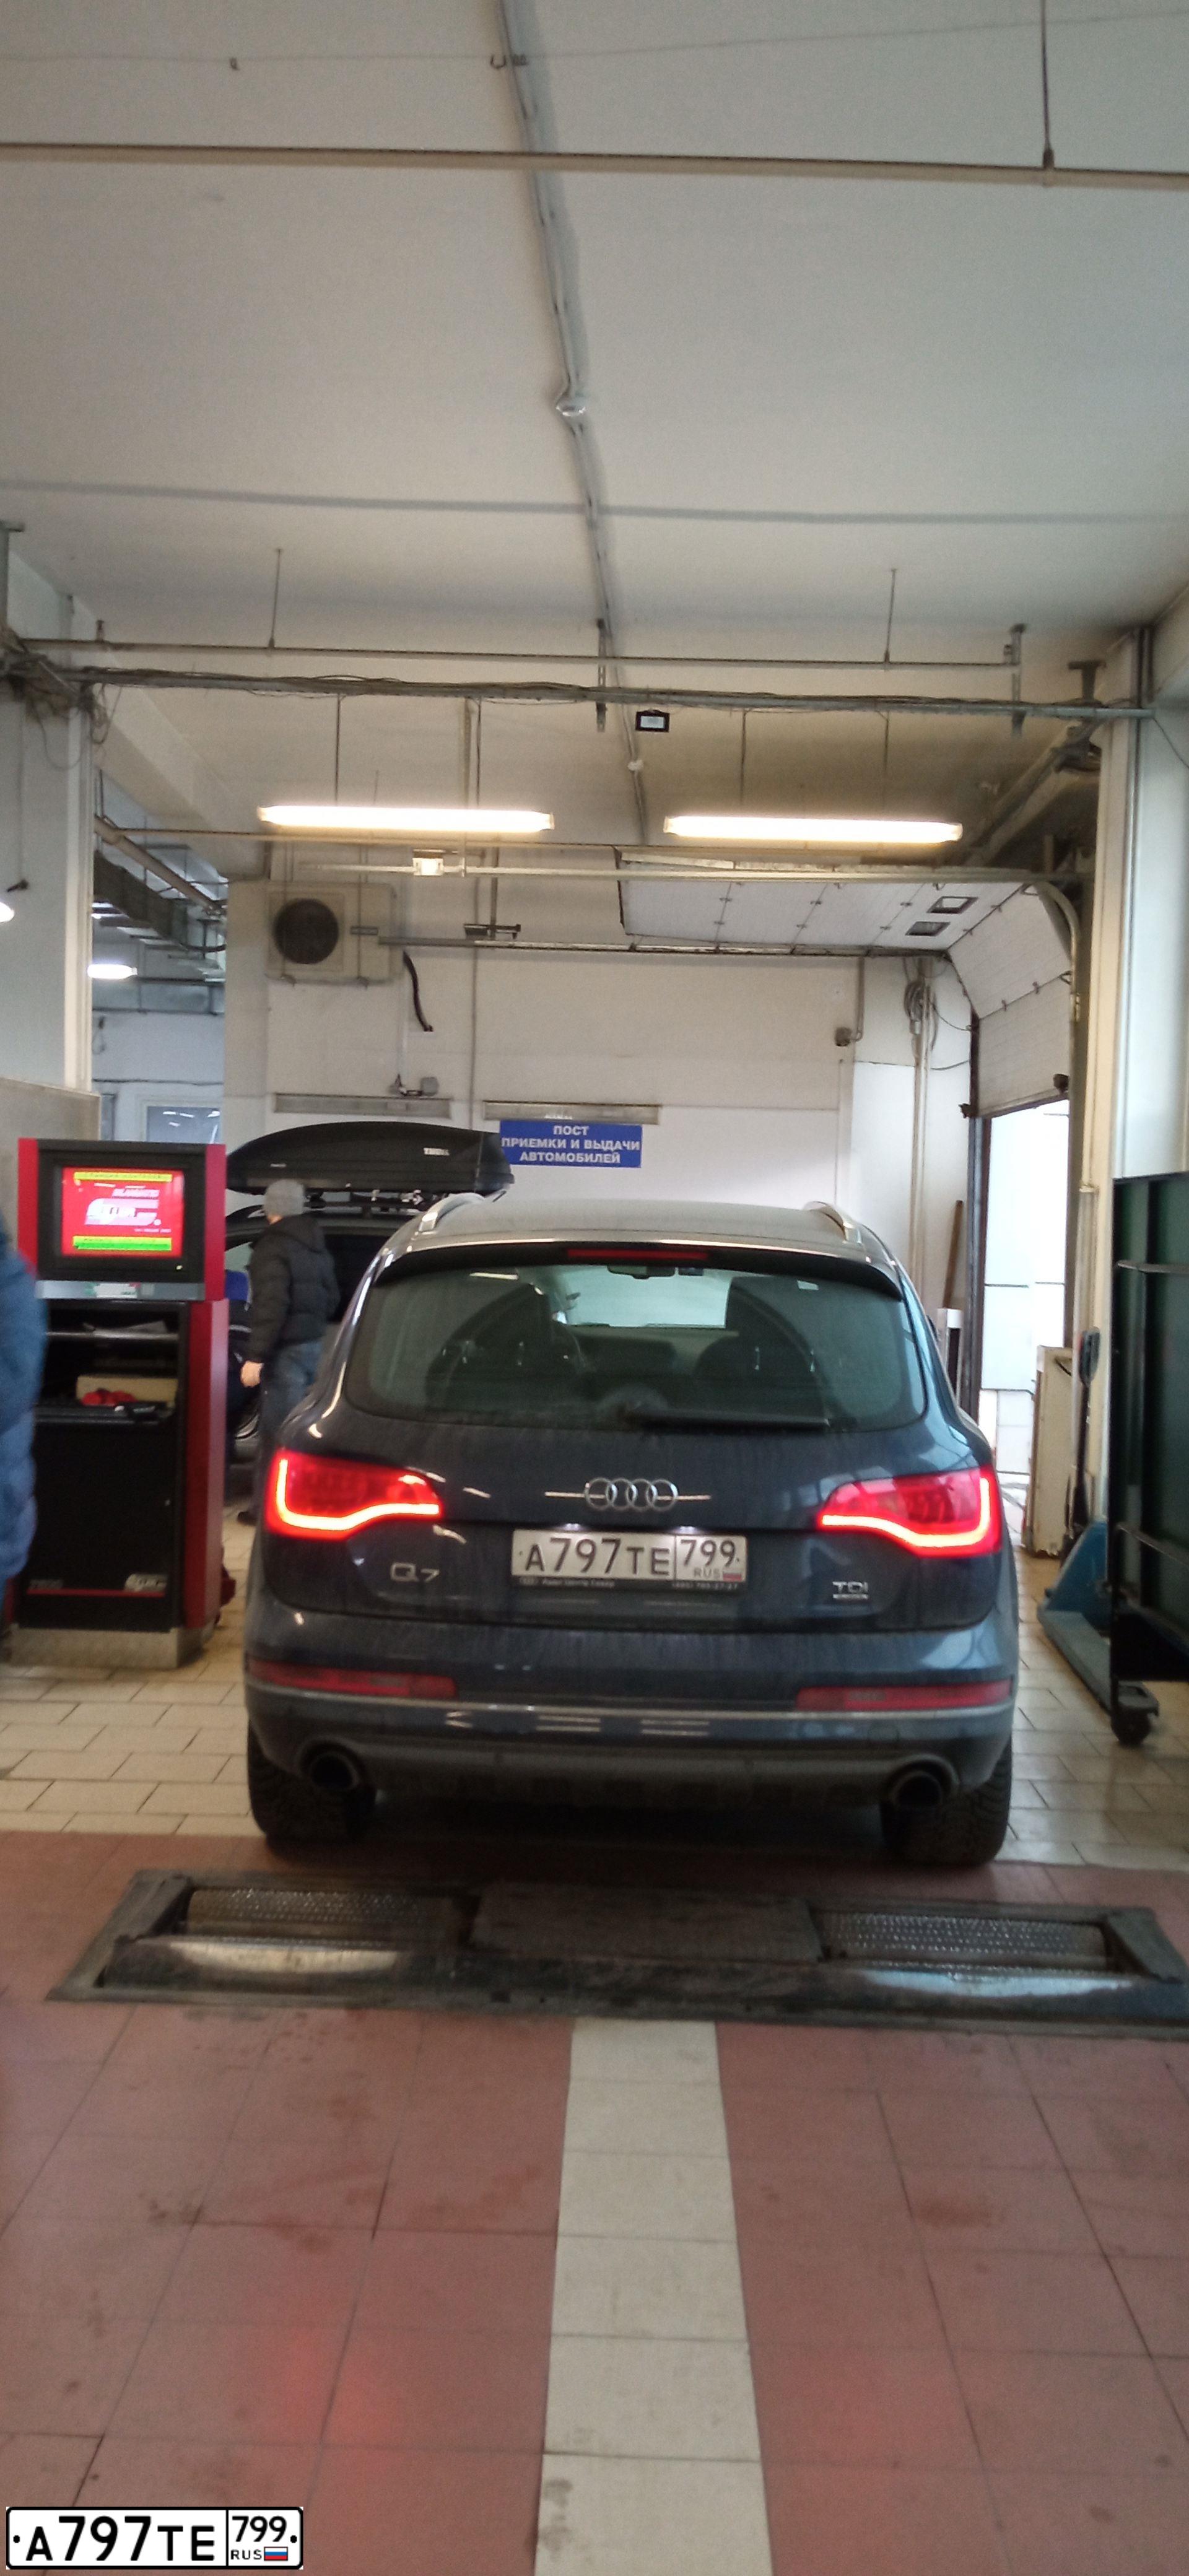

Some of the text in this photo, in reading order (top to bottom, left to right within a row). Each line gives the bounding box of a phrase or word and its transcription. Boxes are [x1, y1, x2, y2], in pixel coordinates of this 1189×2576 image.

[553, 1125, 590, 1136] ПОСТ
[502, 1138, 640, 1152] ПРИЕМКИ И ВЫДАЧИ
[520, 1152, 621, 1164] АВТОМОБИЛЕЙ
[525, 1538, 737, 1575] A797TE 799
[390, 1562, 440, 1582] Q7
[693, 1568, 721, 1580] RUS
[832, 1581, 868, 1593] TDI
